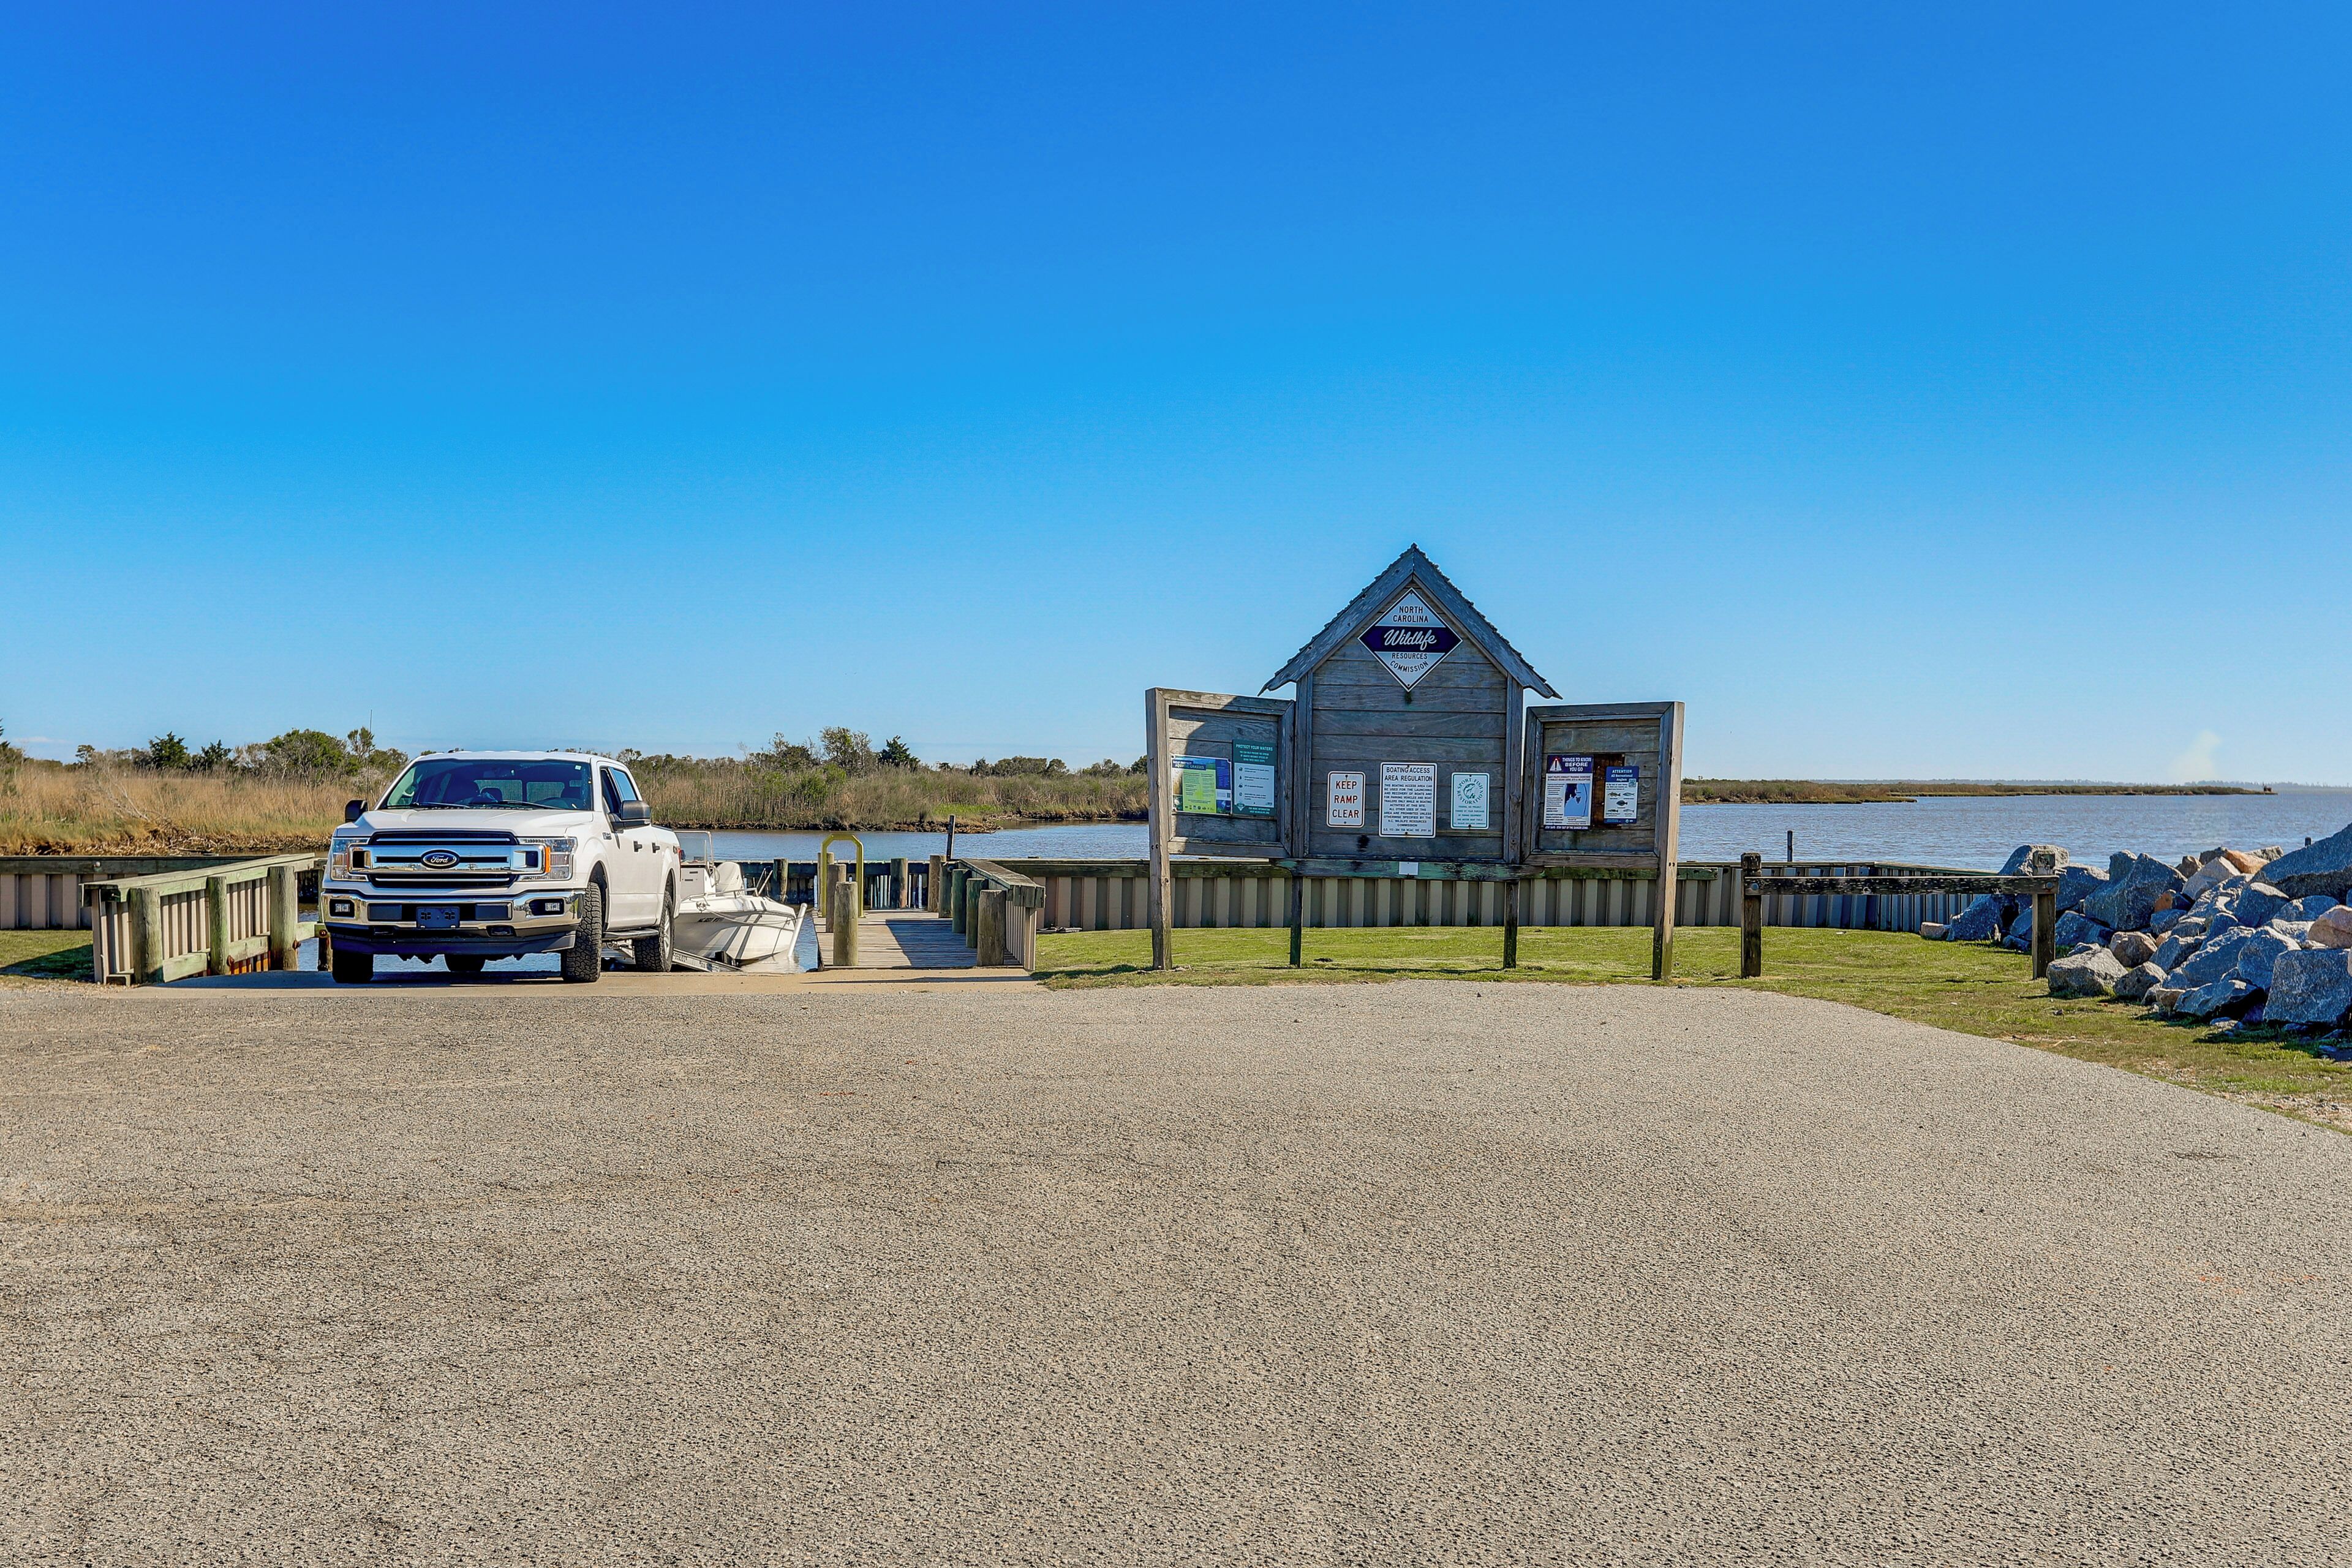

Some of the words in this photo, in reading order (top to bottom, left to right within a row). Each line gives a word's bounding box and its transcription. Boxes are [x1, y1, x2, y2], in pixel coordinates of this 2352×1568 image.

[1384, 629, 1437, 650] Wildlife
[1390, 660, 1429, 673] COMMISSION
[1336, 781, 1357, 789] KEEP
[1458, 778, 1472, 789] SPORT
[1474, 779, 1483, 789] FISH
[1334, 795, 1358, 804] RAMP
[1332, 809, 1359, 818] CLEAR
